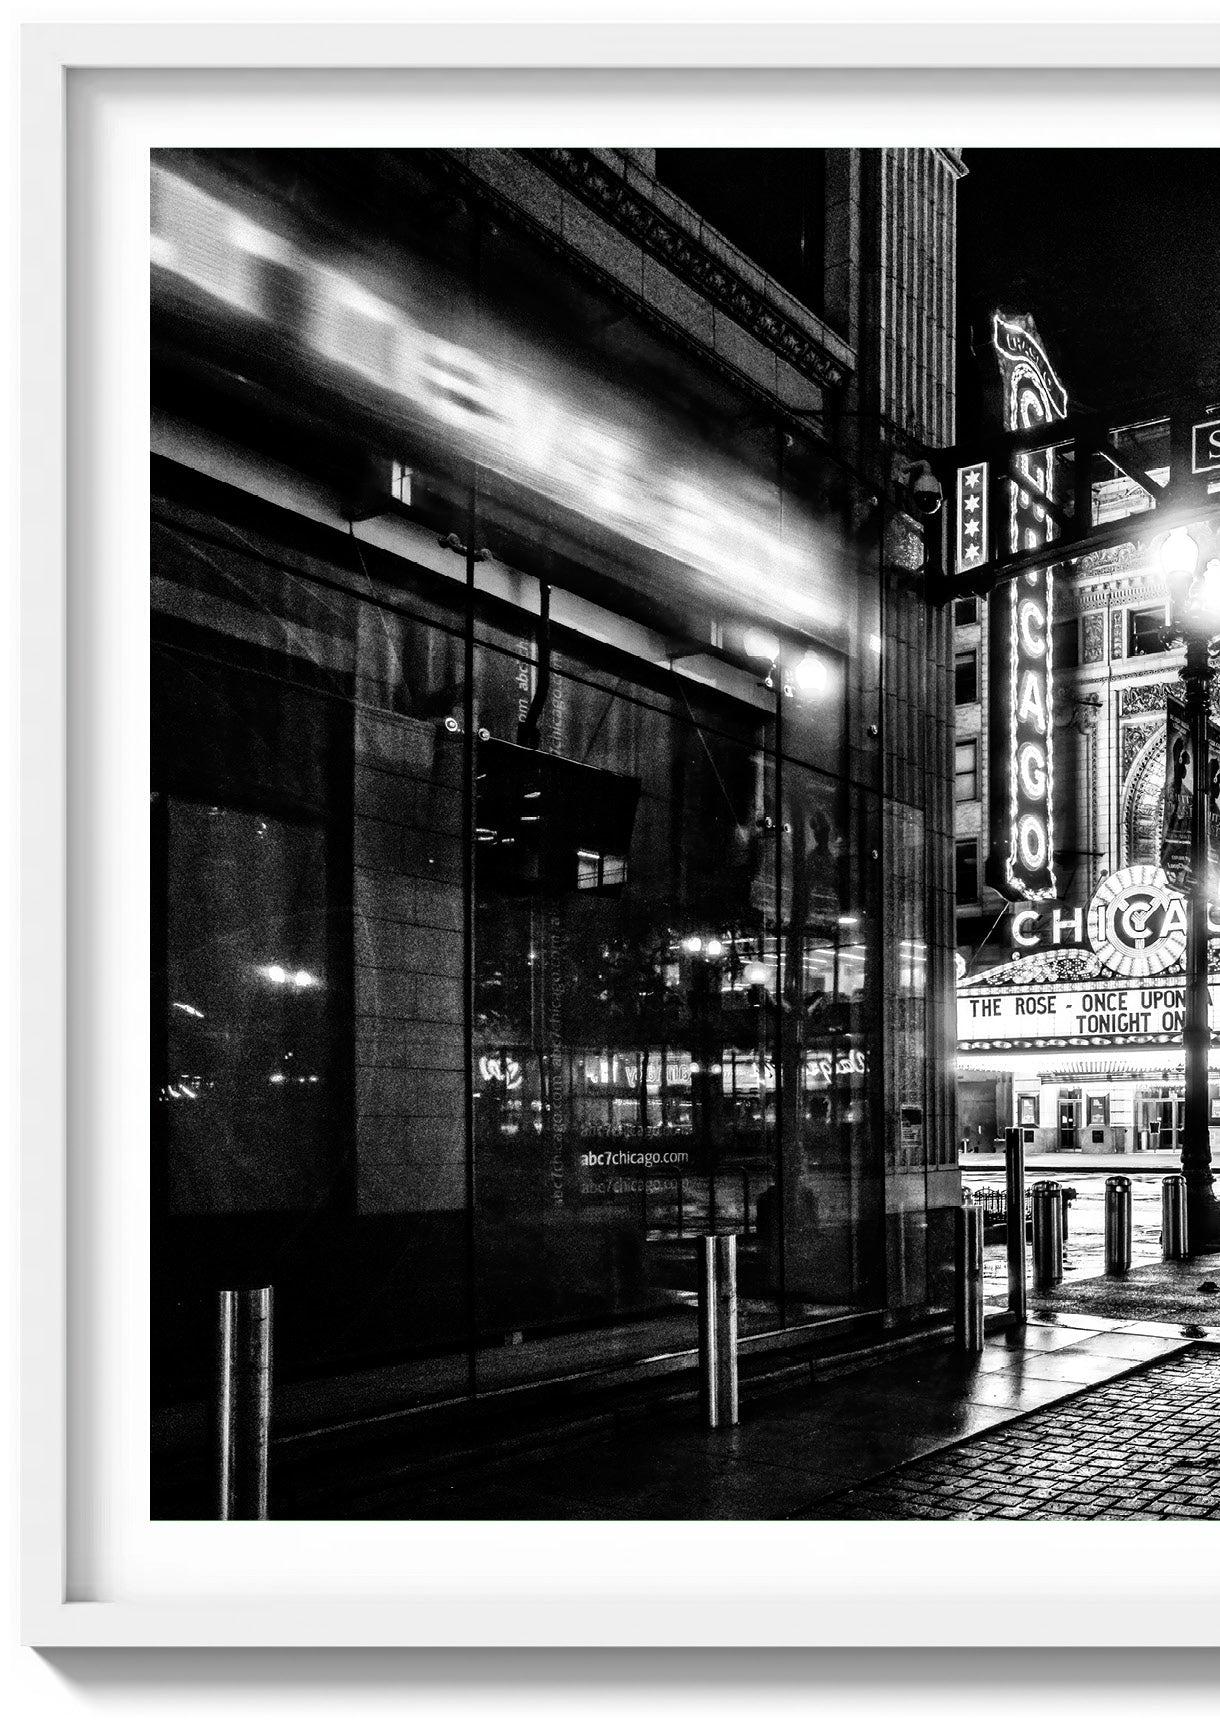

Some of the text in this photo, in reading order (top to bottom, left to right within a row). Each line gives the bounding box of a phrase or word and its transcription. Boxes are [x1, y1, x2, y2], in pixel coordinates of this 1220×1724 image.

[970, 998, 1002, 1017] THE
[1015, 995, 1056, 1015] ROSE
[1082, 991, 1128, 1012] ONCE
[1141, 990, 1187, 1010] UPON
[1076, 1012, 1151, 1034] TONIGHT
[580, 1149, 689, 1168] abc7chicago.com
